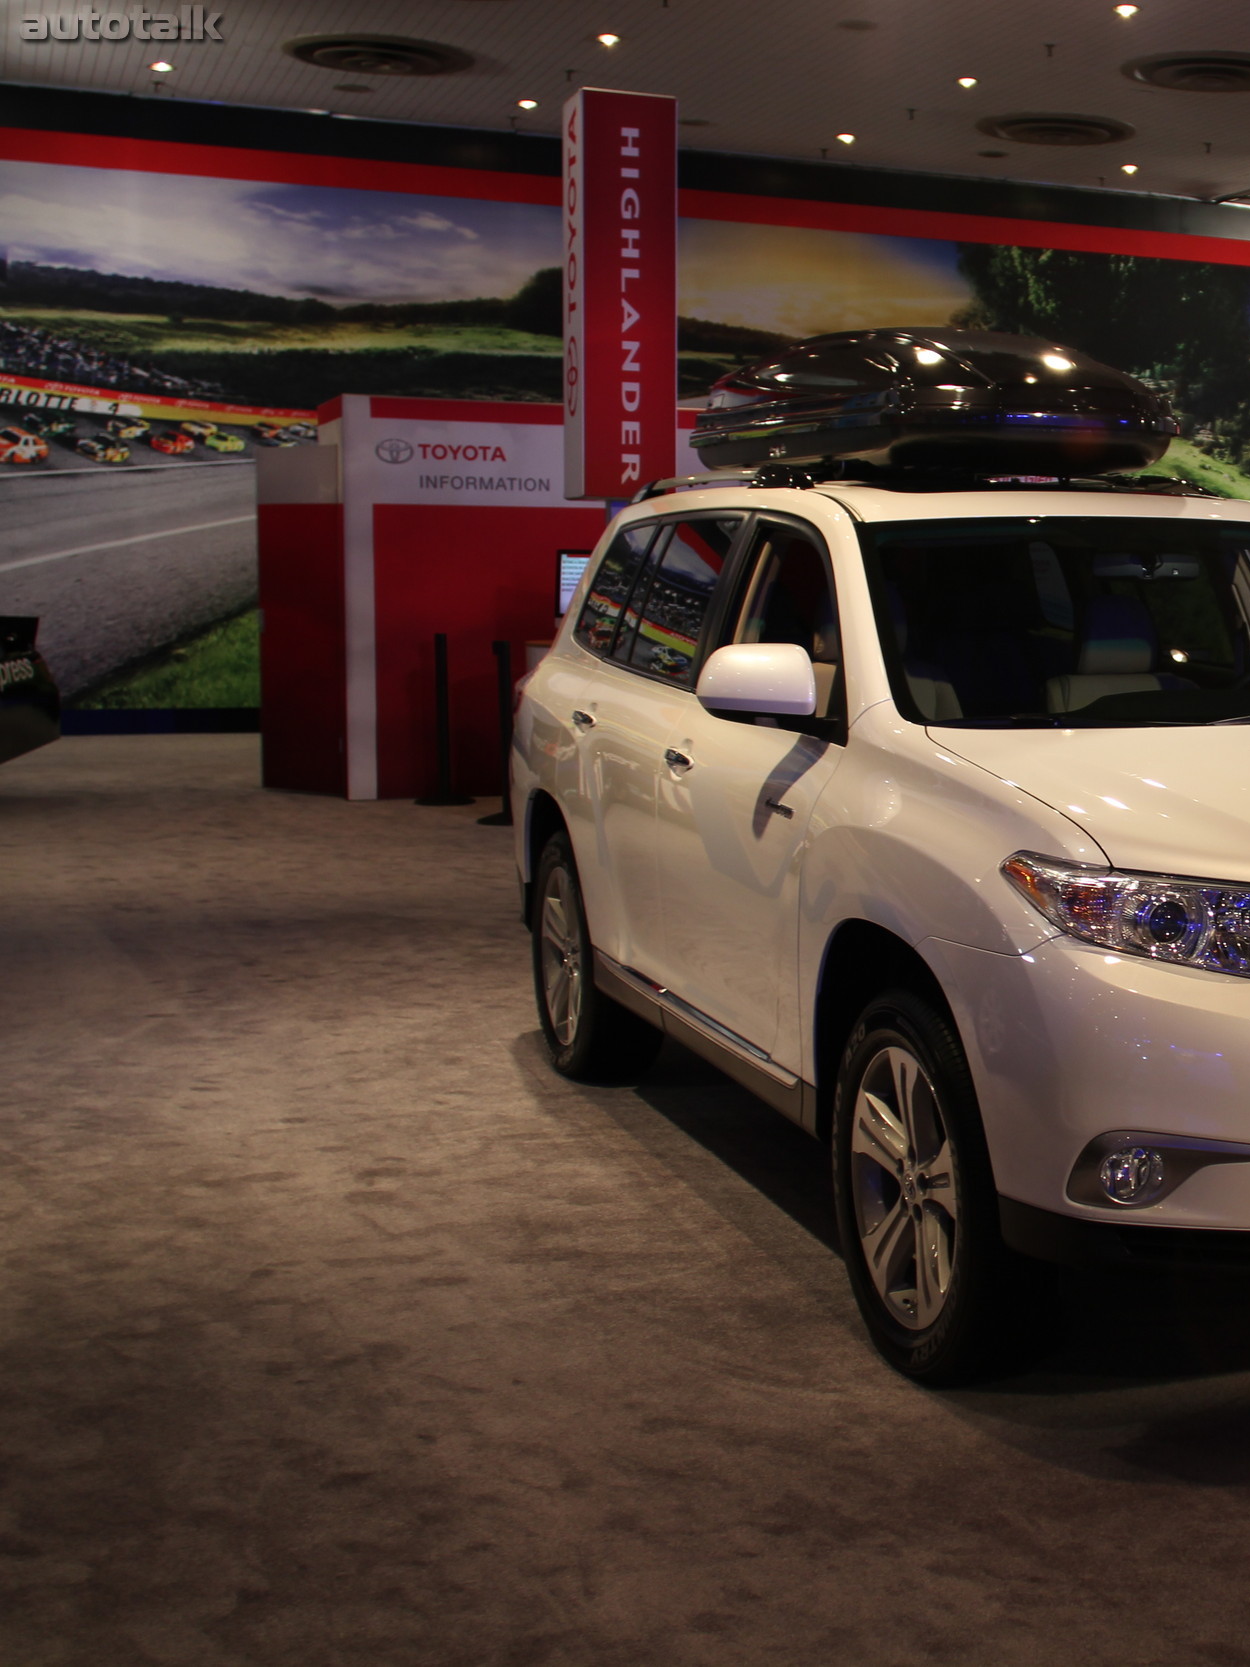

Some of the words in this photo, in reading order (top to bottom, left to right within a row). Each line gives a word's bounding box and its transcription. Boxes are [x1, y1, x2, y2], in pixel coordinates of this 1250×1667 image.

[567, 108, 577, 323] TOYOTA
[620, 127, 641, 485] HIGHLANDER
[418, 443, 507, 462] TOYOTA
[419, 475, 550, 491] INFORMATION
